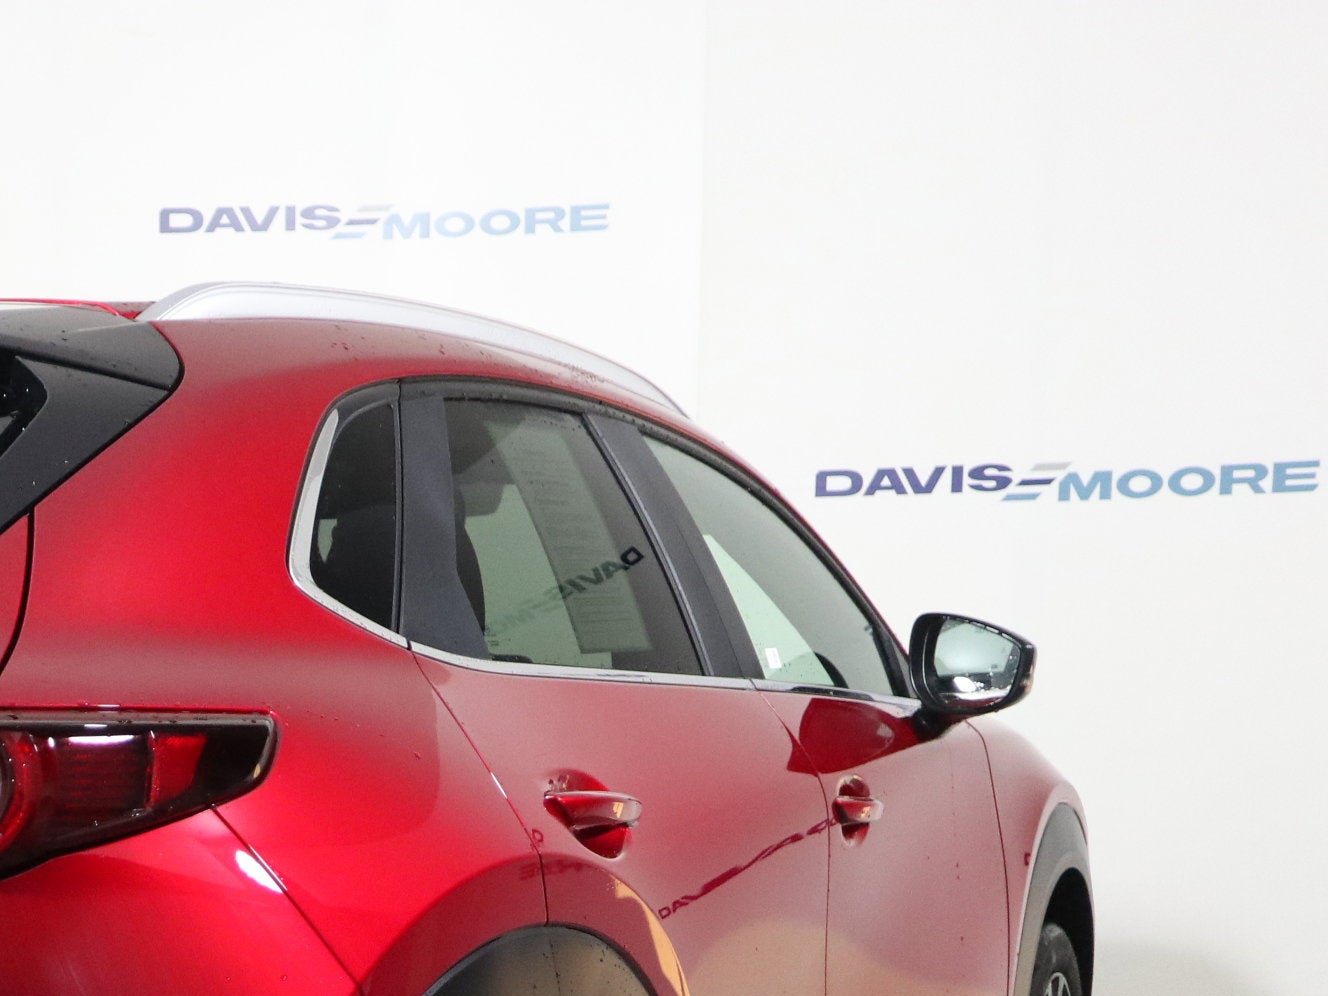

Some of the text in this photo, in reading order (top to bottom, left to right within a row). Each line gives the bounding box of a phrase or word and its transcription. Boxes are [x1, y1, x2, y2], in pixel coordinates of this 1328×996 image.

[158, 202, 610, 240] DAVIS MOORE
[814, 459, 1321, 502] DAVIS MOORE
